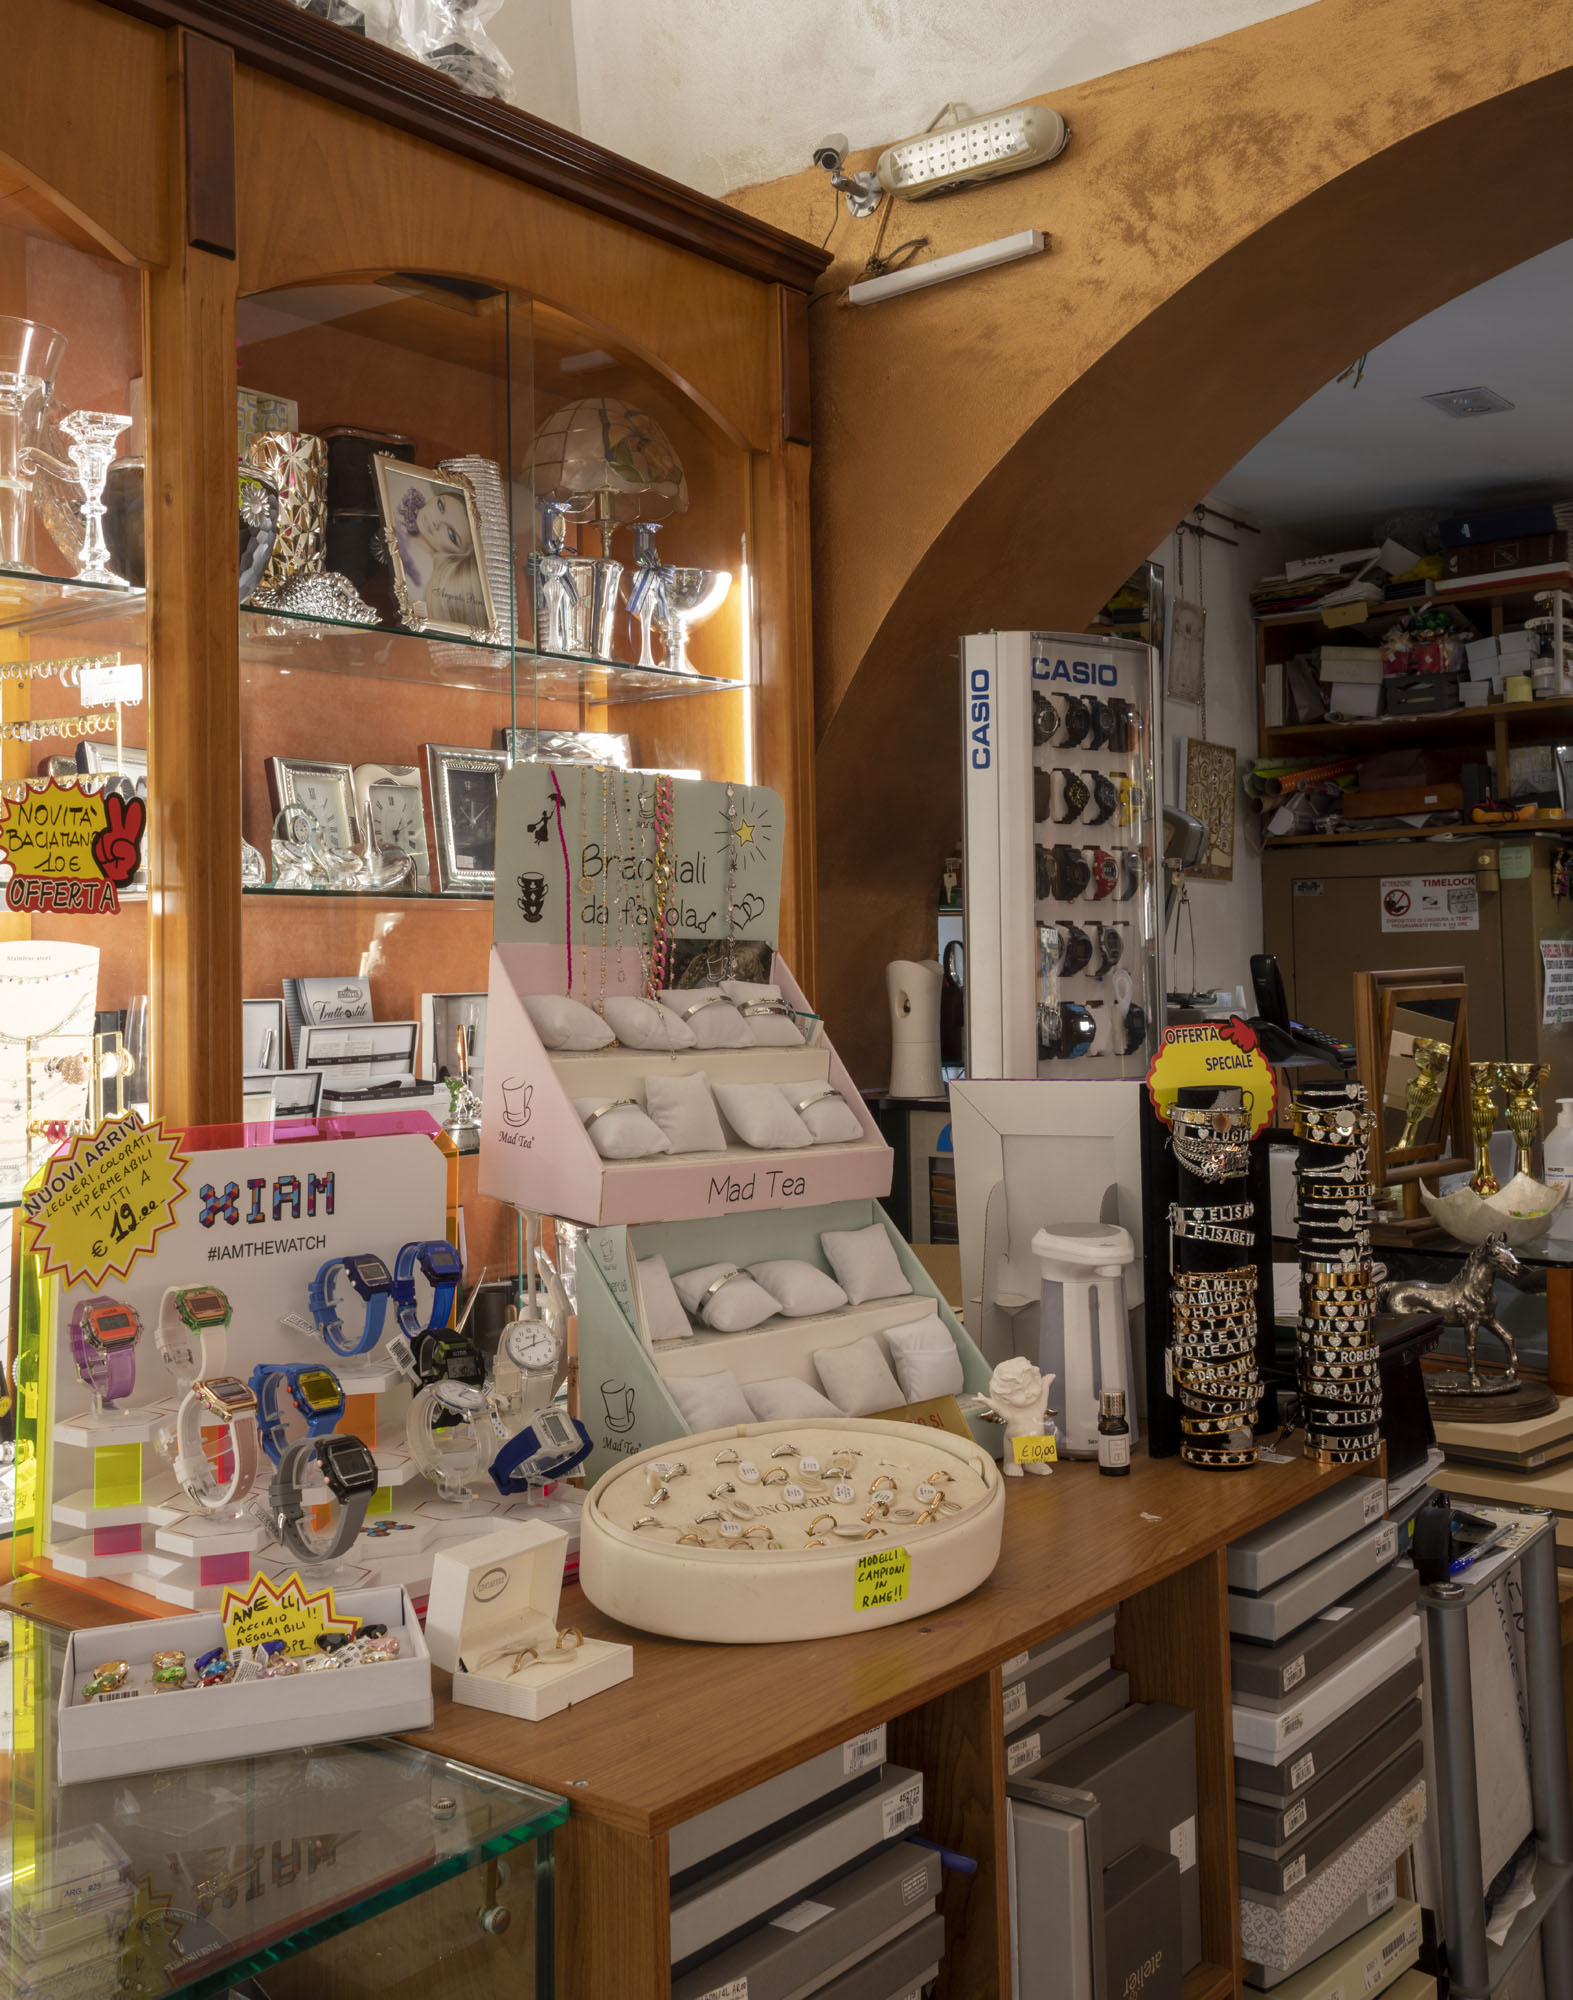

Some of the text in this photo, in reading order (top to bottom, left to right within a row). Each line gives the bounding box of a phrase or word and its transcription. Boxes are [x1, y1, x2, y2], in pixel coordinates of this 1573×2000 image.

[1032, 657, 1118, 687] CASIO
[971, 669, 991, 769] CASIO
[581, 843, 706, 884] Braciali
[1422, 877, 1476, 887] TIMELOCK
[11, 879, 116, 911] OFFERTA
[581, 895, 609, 924] da
[1165, 1027, 1220, 1045] OFFERTA
[1205, 1054, 1253, 1072] SPECIALE
[498, 1130, 519, 1145] Mad
[24, 1112, 144, 1217] NUOVI ARRIVI
[100, 1134, 151, 1175] COLORATI
[71, 1149, 153, 1217] IMPERMEABILI
[708, 1170, 806, 1204] Mad Tea
[90, 1170, 151, 1220] TUTTI A
[1210, 1204, 1251, 1221] ELISA
[207, 1234, 327, 1262] #IAMTHEWATCH
[1188, 1276, 1252, 1291] FAMILY
[1192, 1300, 1249, 1319] HAPPY
[1191, 1312, 1251, 1331] STAR
[1185, 1339, 1250, 1358] DREAM
[1207, 1400, 1247, 1414] YOU
[602, 1435, 623, 1452] Mad
[858, 1563, 905, 1583] CAMPIONI
[874, 1580, 887, 1590] IN
[236, 1613, 288, 1636] ACCIAIO
[237, 1621, 306, 1648] REGOLABILI
